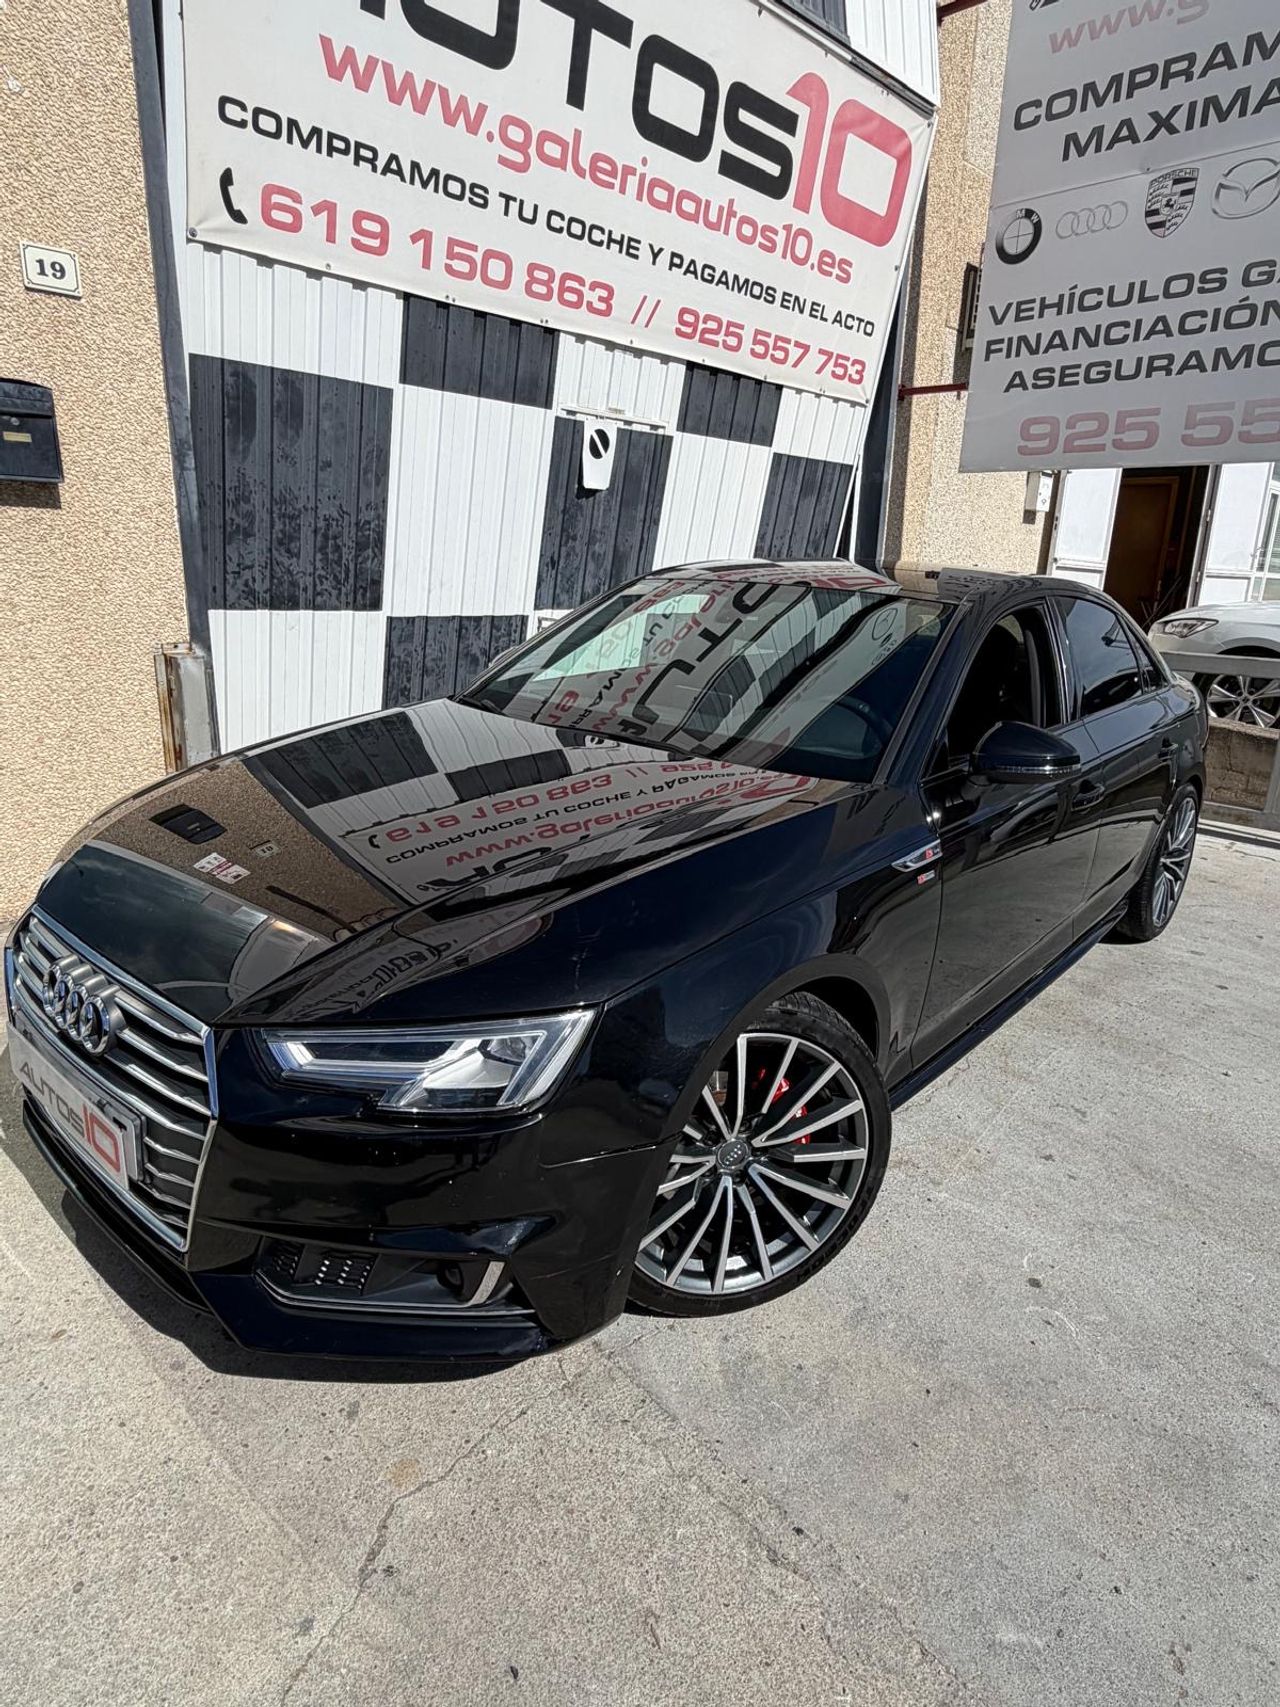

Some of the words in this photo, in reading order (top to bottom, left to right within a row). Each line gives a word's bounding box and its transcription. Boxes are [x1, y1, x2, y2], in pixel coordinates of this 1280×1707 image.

[360, 0, 912, 248] UTOS10
[1013, 28, 1280, 132] COMPRAM
[318, 34, 854, 285] www.galeriaautos10.es
[35, 258, 67, 281] 19
[217, 95, 490, 209] COMPRAMOS
[498, 191, 539, 226] TU
[546, 209, 641, 260] COCHE
[648, 243, 665, 266] Y
[668, 251, 777, 305] PAGAMOS
[780, 291, 807, 314] EN
[809, 301, 829, 323] EL
[831, 310, 876, 338] ACTO
[260, 183, 391, 257] 619
[409, 228, 514, 291] 150
[524, 261, 615, 318] 863
[675, 306, 746, 354] 925
[749, 328, 811, 368] 557
[815, 347, 867, 386] 753
[988, 267, 1229, 327] VEHÍCULOS
[1241, 259, 1280, 288] G
[1017, 407, 1162, 456] 925
[1179, 397, 1280, 447] 55
[19, 1061, 121, 1173] AUTOS10
